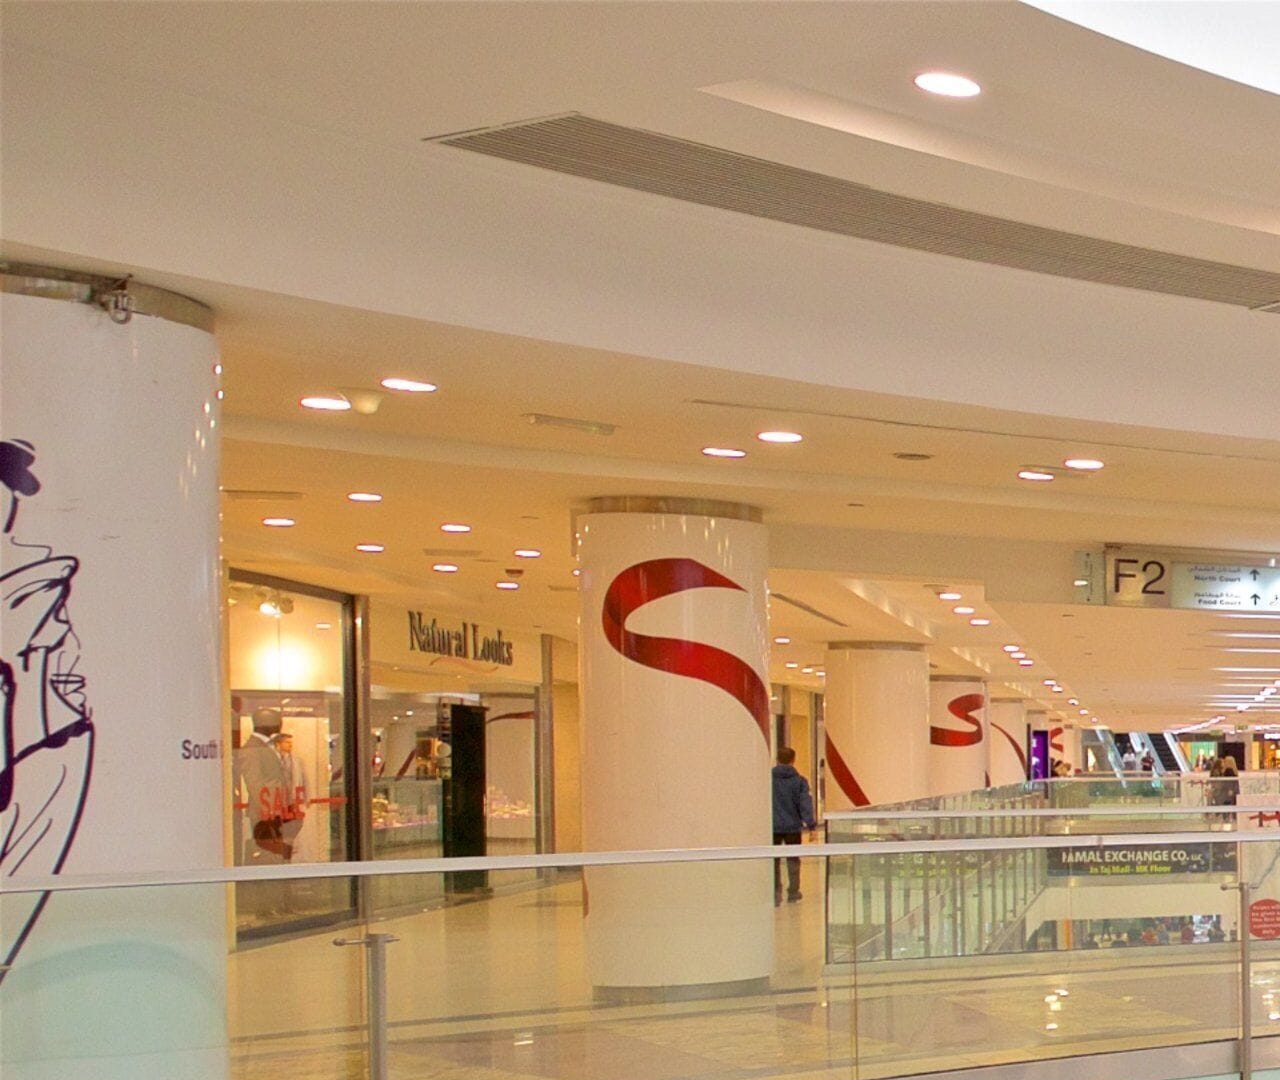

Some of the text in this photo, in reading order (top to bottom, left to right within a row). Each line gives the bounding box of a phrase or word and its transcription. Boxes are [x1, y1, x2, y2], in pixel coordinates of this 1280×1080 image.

[1114, 558, 1166, 595] F2
[407, 610, 513, 667] Natural Looks
[259, 786, 306, 822] SALE
[1104, 849, 1169, 862] EXCHANGE
[1171, 849, 1190, 861] CO.
